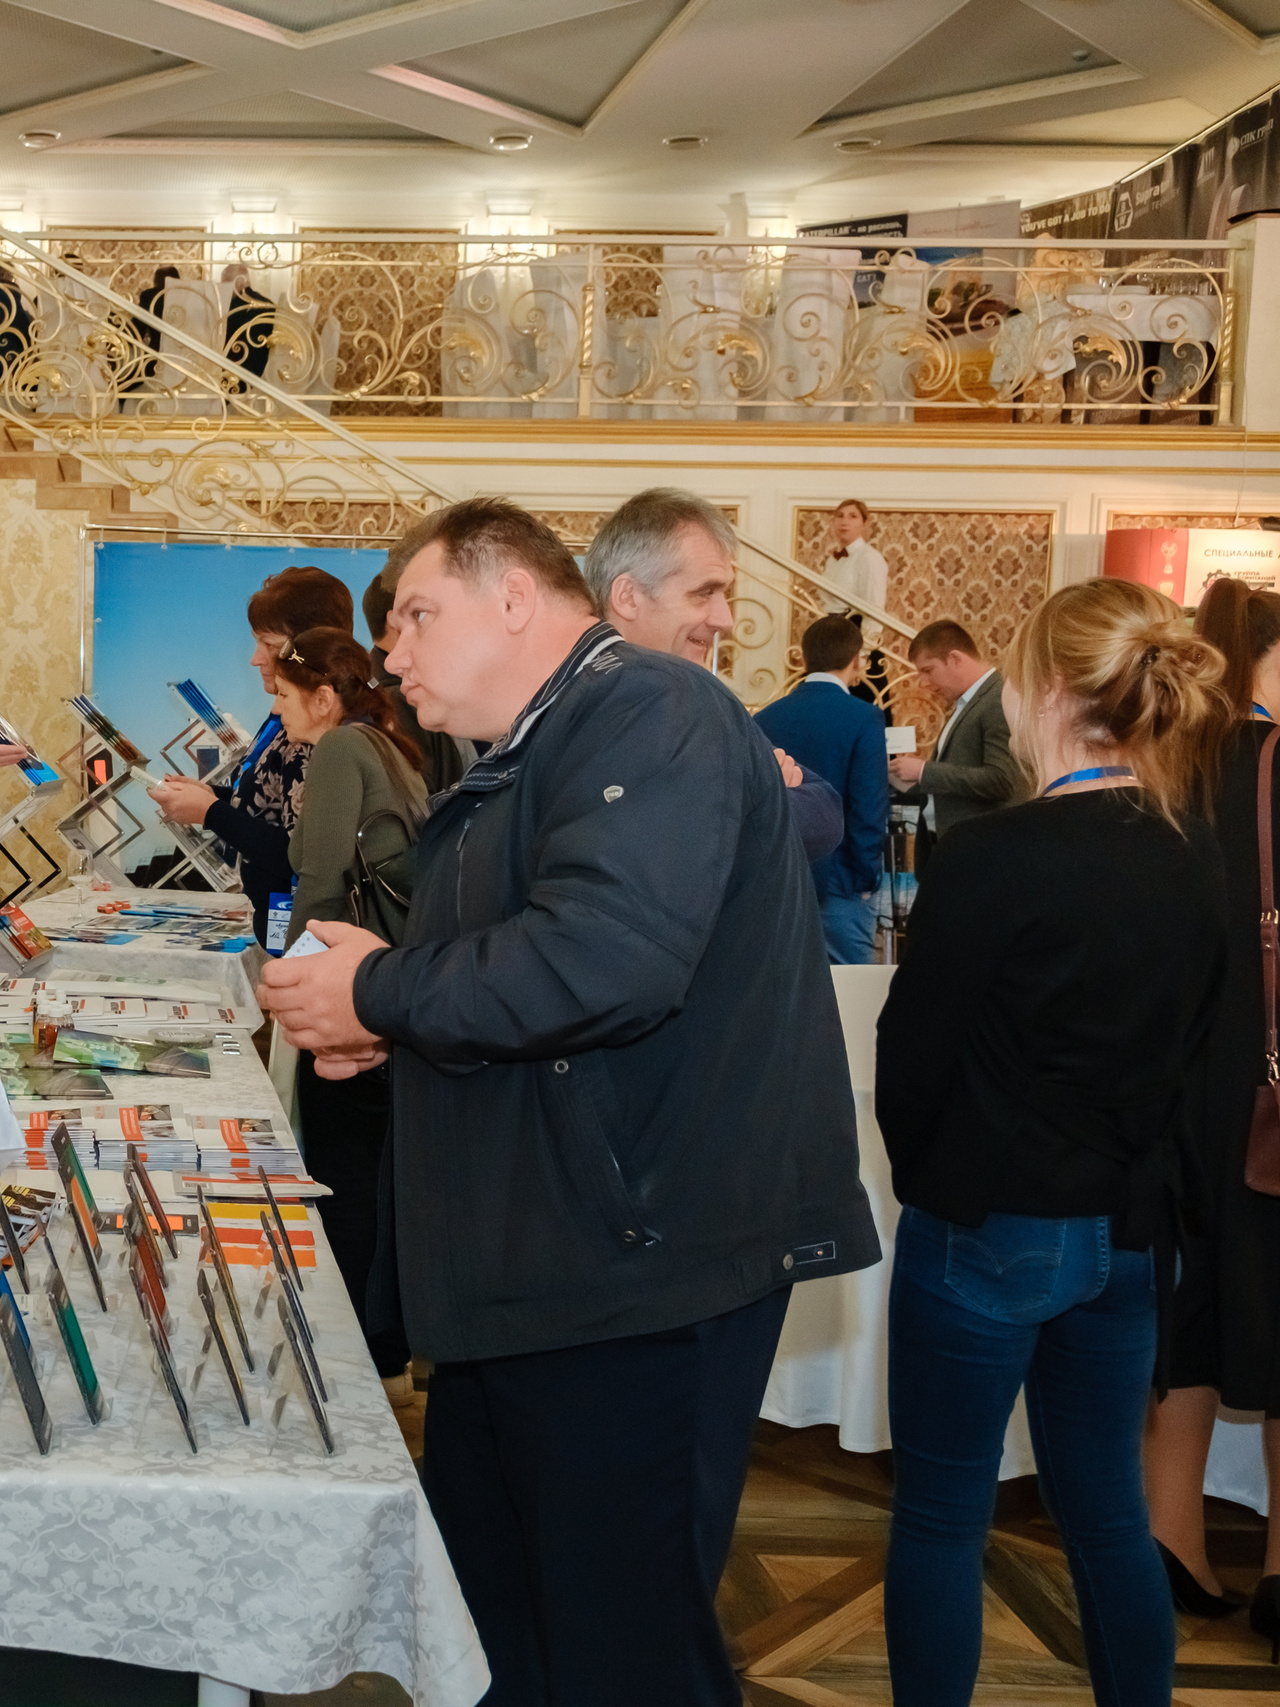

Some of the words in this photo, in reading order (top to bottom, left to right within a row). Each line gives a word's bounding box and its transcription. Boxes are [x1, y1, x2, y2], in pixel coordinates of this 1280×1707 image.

[1047, 215, 1063, 227] GOT
[1063, 214, 1070, 223] A
[1071, 210, 1086, 222] JOB
[1088, 206, 1098, 217] TO
[1204, 549, 1273, 558] СПЕЦИАЛЬНЫЕ
